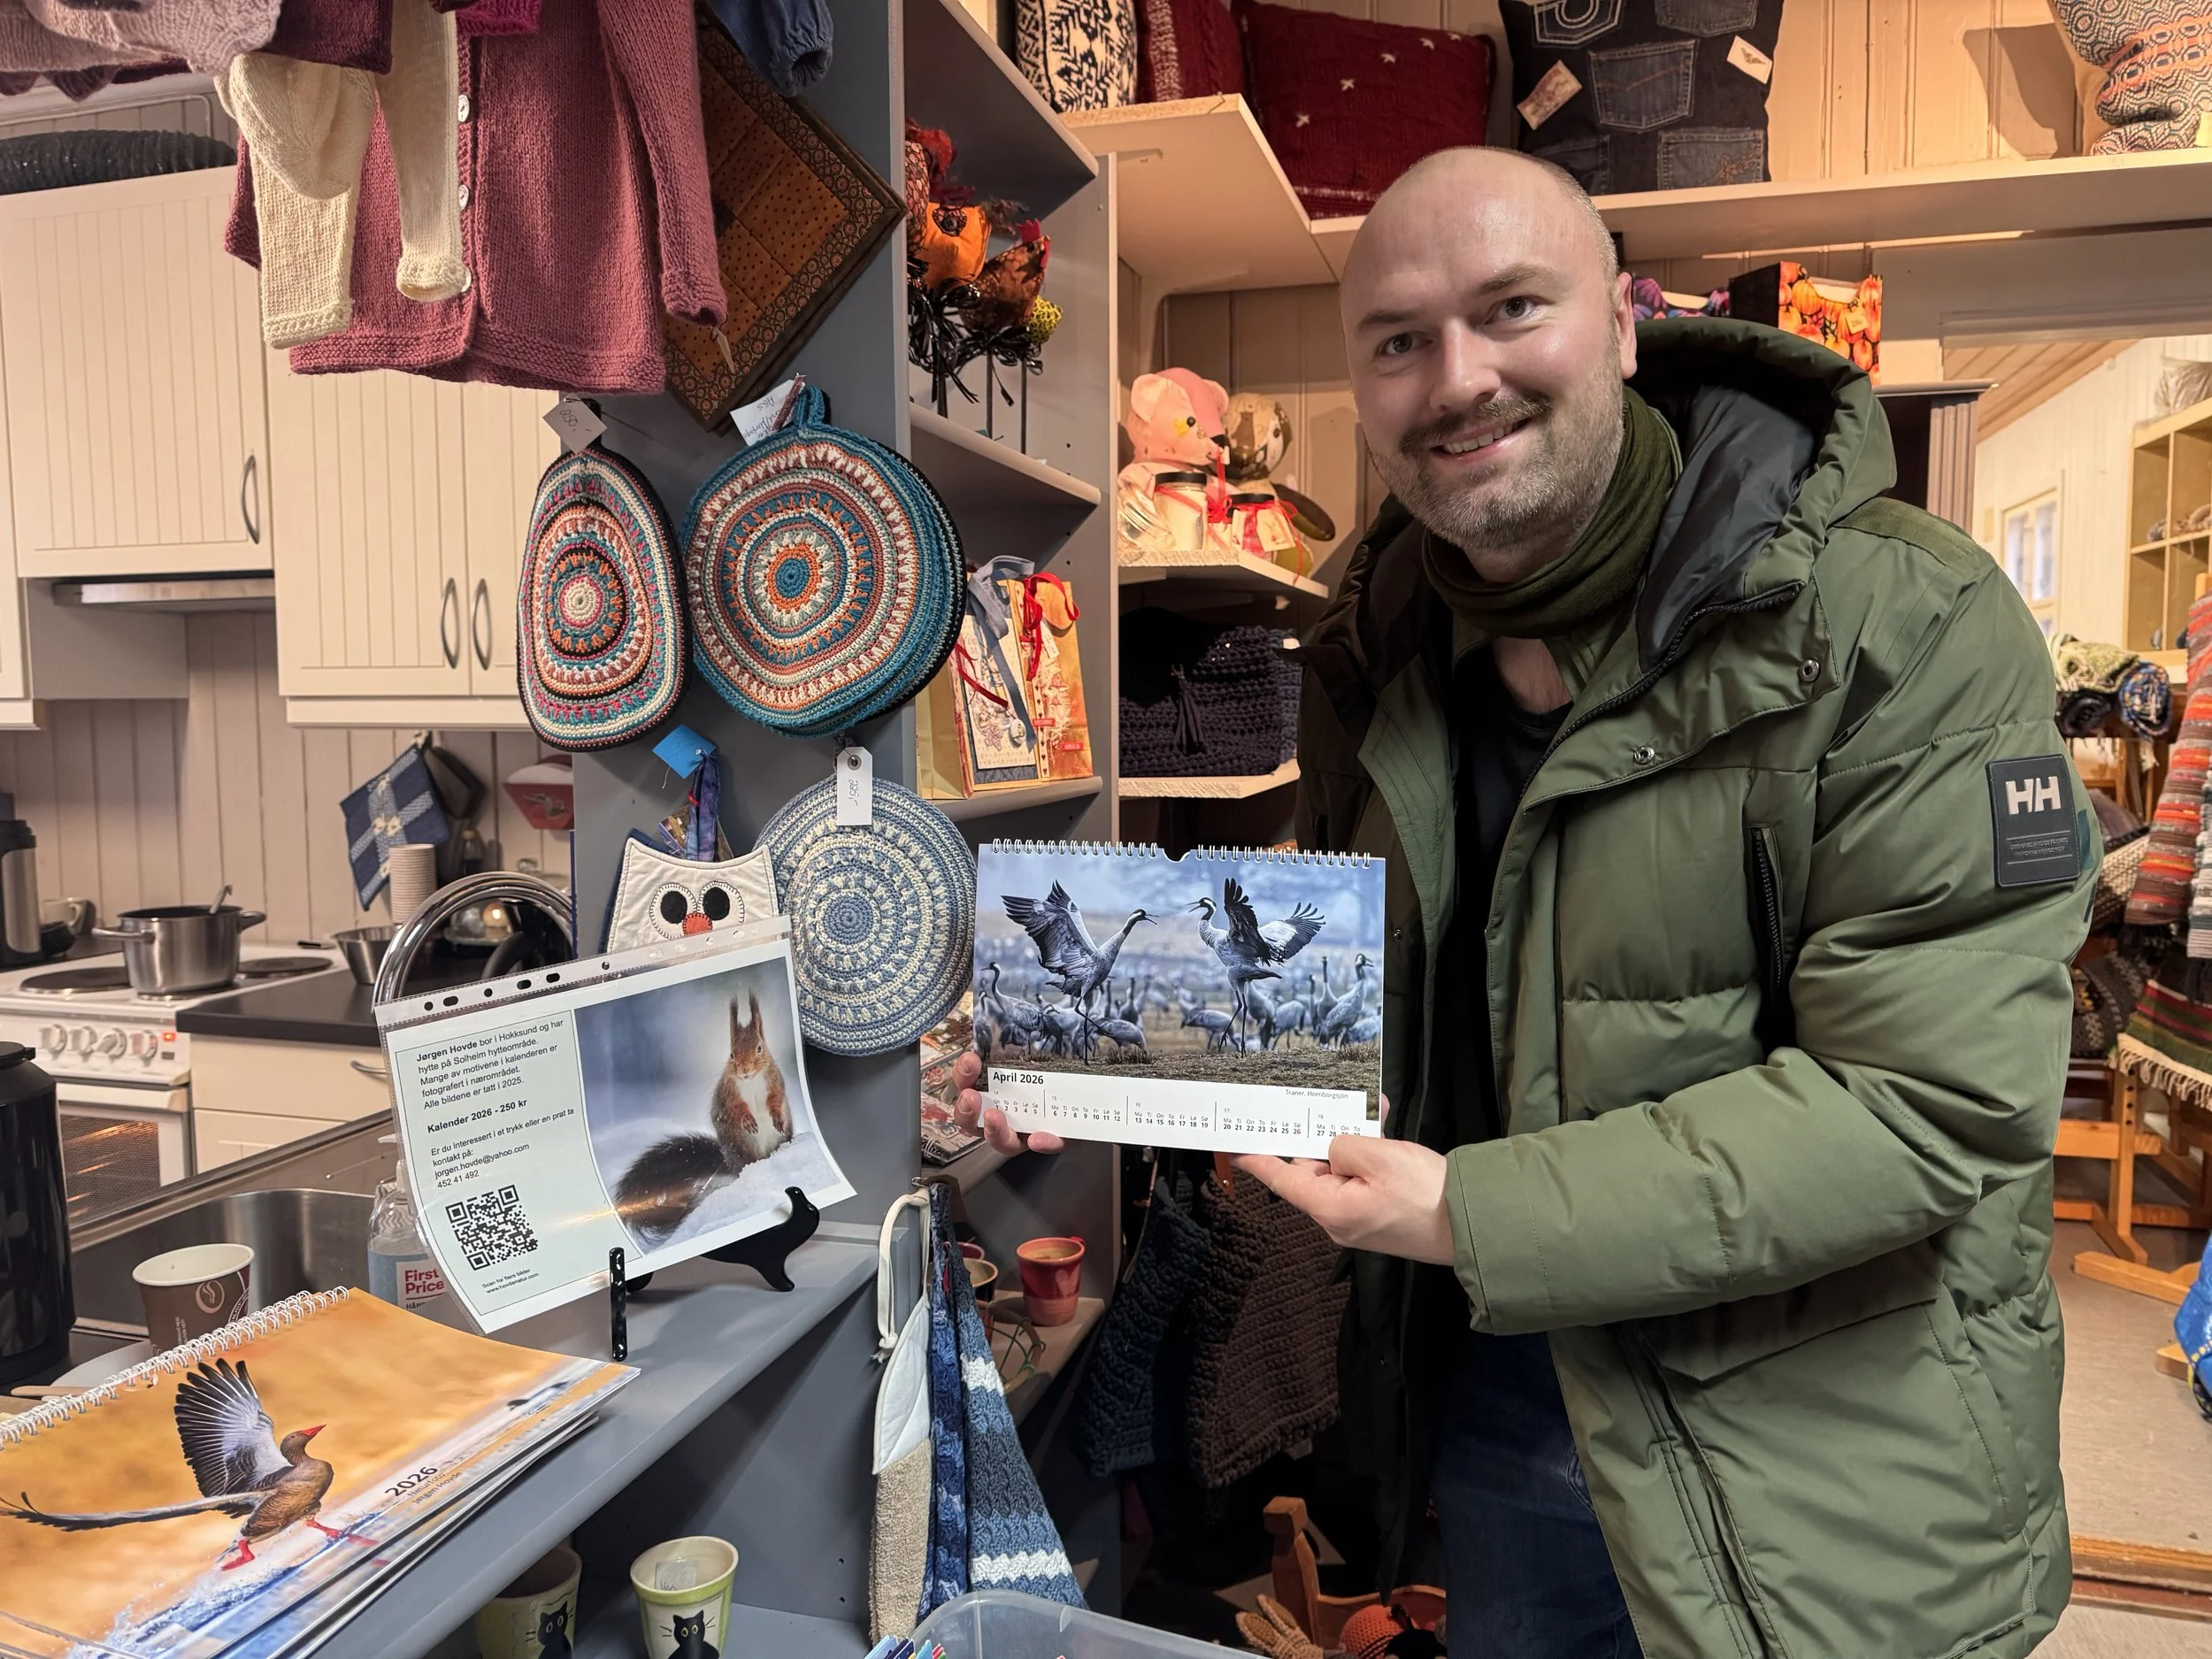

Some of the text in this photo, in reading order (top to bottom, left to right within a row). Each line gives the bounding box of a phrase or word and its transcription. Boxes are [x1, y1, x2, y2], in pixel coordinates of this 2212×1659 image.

[2005, 776, 2062, 815] HH
[417, 1049, 448, 1062] Jørgen
[449, 1041, 478, 1054] Hovde
[480, 1037, 493, 1047] bor
[499, 1025, 538, 1041] Hokksund
[539, 1024, 549, 1033] og
[550, 1019, 564, 1030] har
[419, 1038, 539, 1074] hytte på Solheim hytteområde.
[420, 1071, 449, 1086] Mange
[450, 1069, 461, 1078] av
[463, 1059, 499, 1075] motivene
[505, 1046, 548, 1064] kalenderen
[549, 1044, 557, 1053] er
[422, 1079, 465, 1098] fotografert
[471, 1065, 521, 1086] nærområdet.
[993, 1071, 1044, 1085] April 2026
[424, 1098, 440, 1110] Alle
[442, 1089, 472, 1105] bildene
[483, 1082, 495, 1094] tatt
[502, 1076, 525, 1089] 2025.
[427, 1116, 469, 1133] Kalender
[471, 1108, 493, 1122] 2026
[500, 1102, 516, 1114] 250
[518, 1098, 527, 1108] kr
[431, 1148, 441, 1156] Er
[442, 1144, 452, 1154] du
[453, 1133, 492, 1150] interessert
[497, 1128, 505, 1137] et
[506, 1122, 524, 1135] trykk
[525, 1118, 541, 1128] eller
[541, 1115, 551, 1124] en
[552, 1110, 566, 1122] prat
[433, 1148, 474, 1168] kontakt på:
[434, 1143, 530, 1180] jorgen.hovde@yahoo.com
[437, 1169, 480, 1189] 452 41 492
[404, 1268, 440, 1282] First
[405, 1280, 445, 1294] Price
[482, 1279, 495, 1288] Scan
[385, 1466, 438, 1496] 2026
